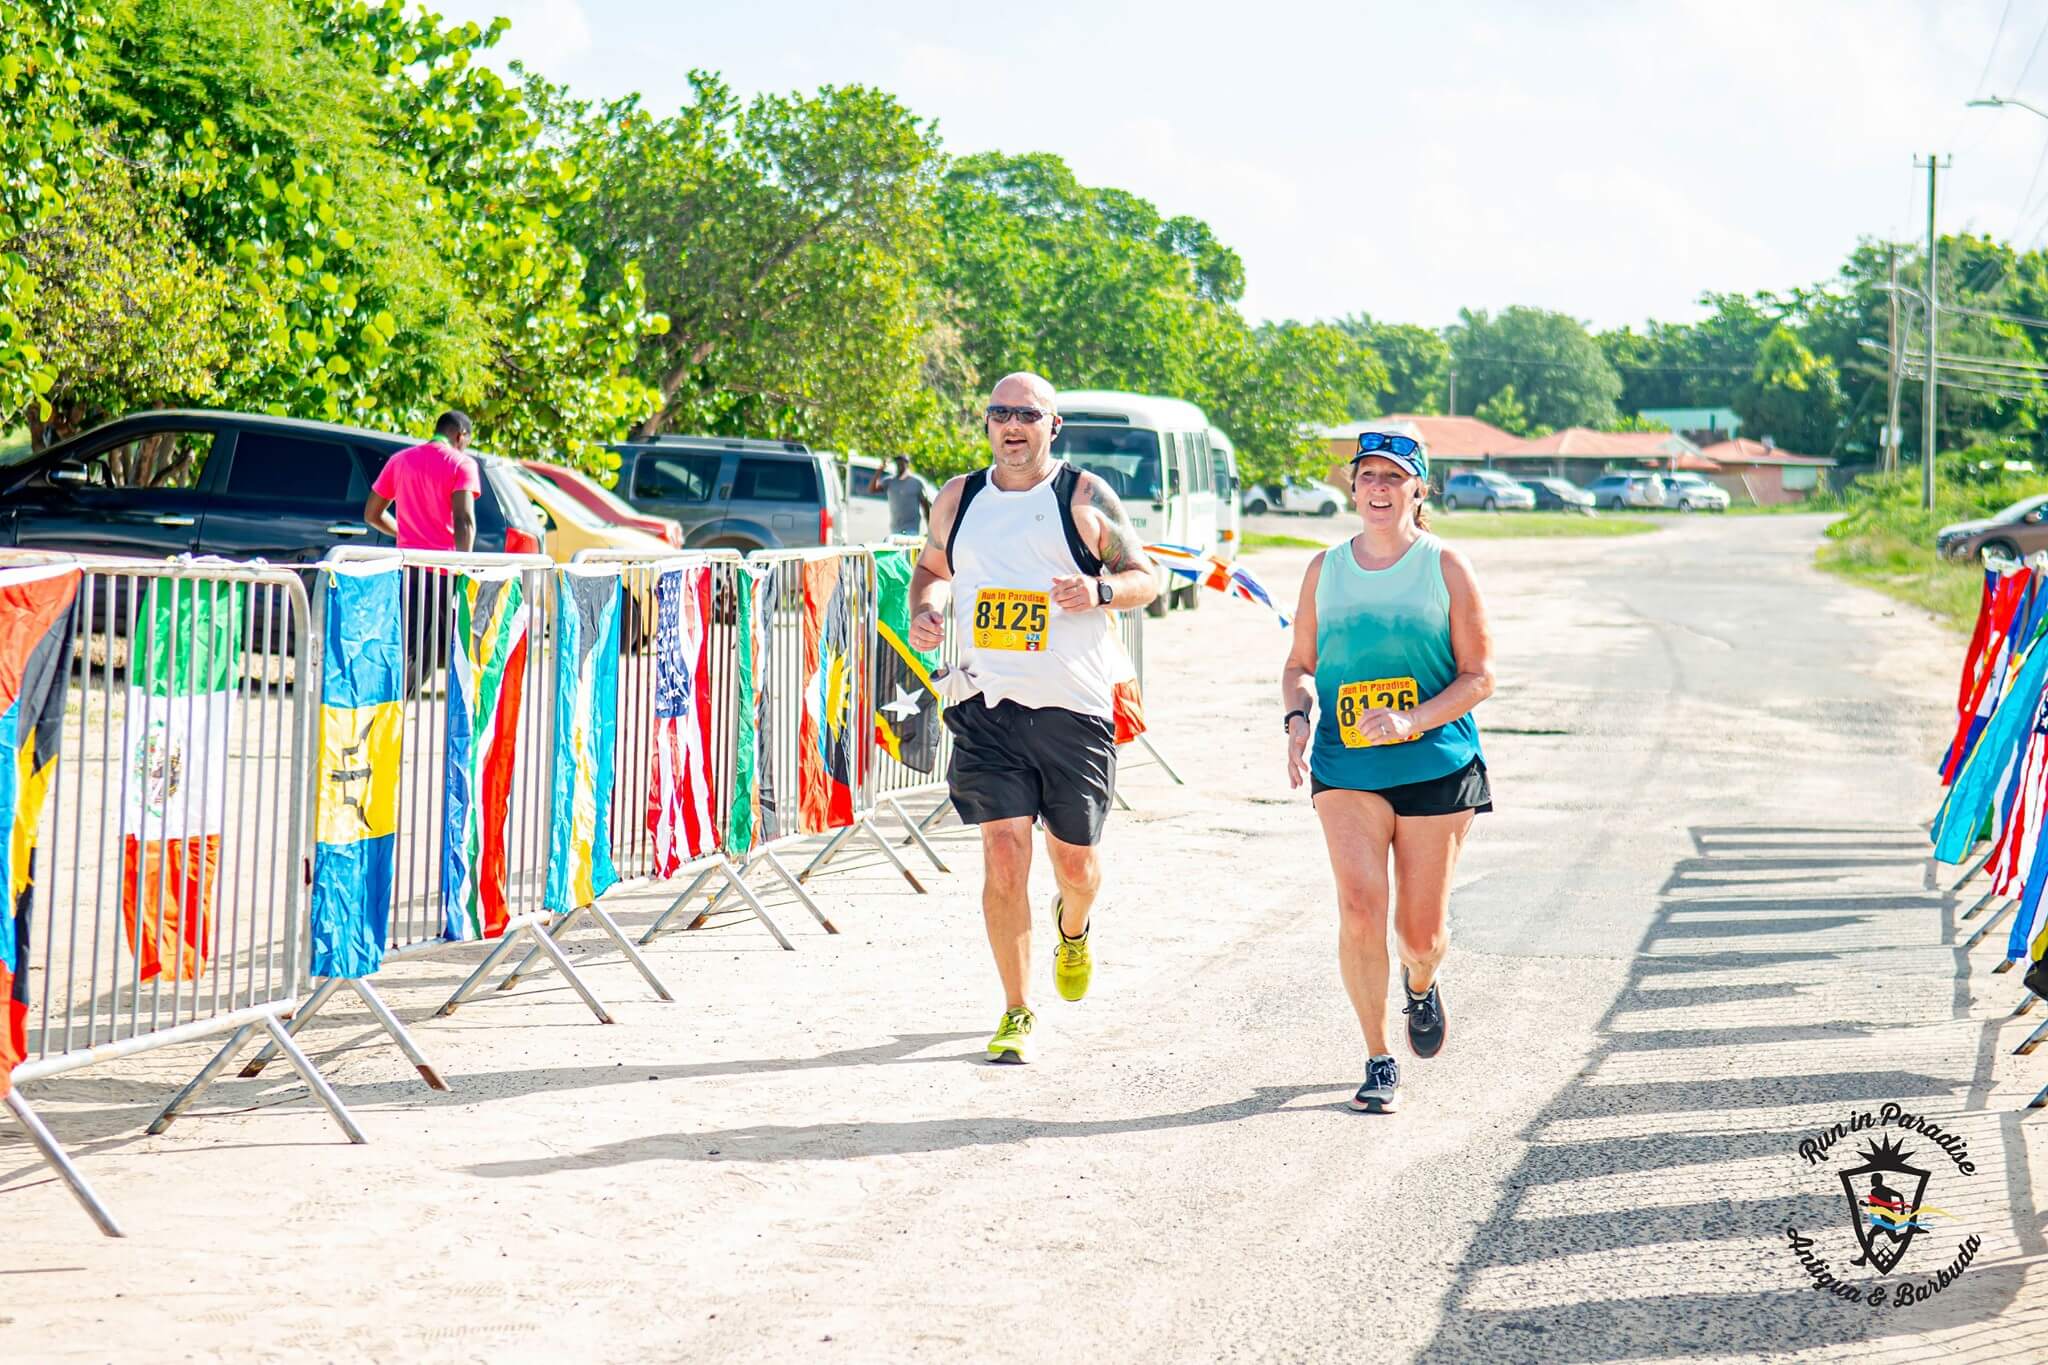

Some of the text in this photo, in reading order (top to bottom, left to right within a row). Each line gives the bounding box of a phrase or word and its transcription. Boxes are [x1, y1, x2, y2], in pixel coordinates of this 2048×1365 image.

[982, 591, 1045, 603] Run In Paradise
[976, 601, 1046, 632] 8125
[1371, 681, 1410, 691] Paradise
